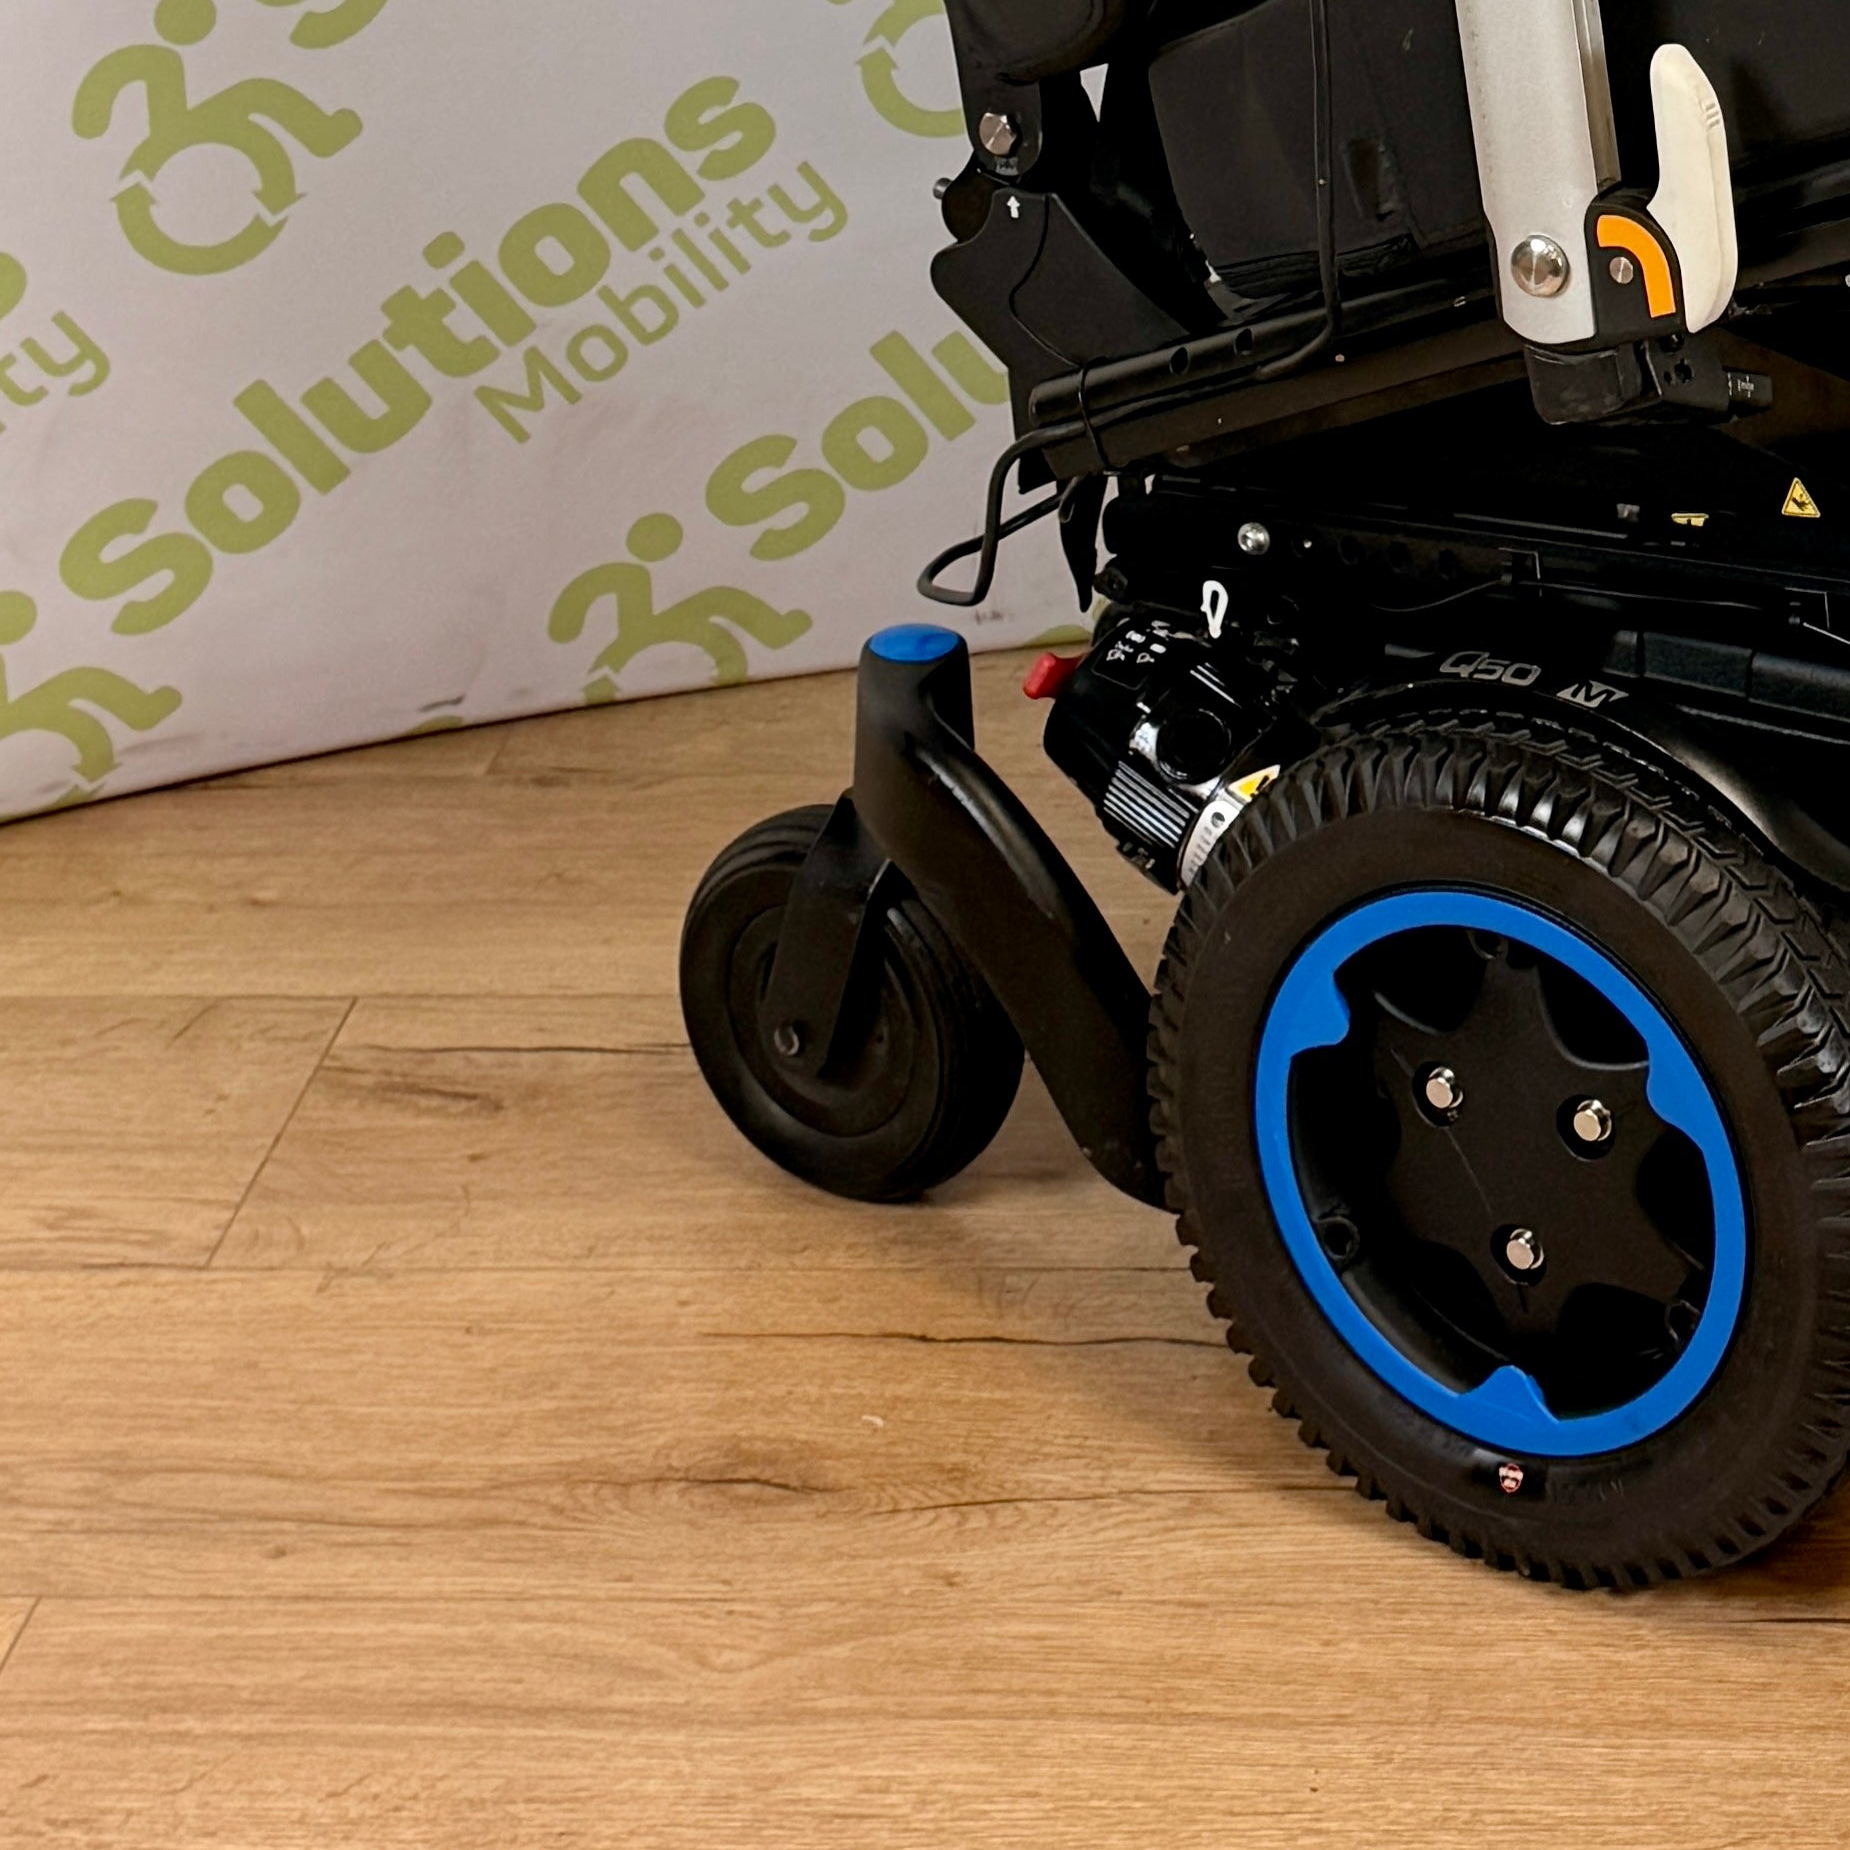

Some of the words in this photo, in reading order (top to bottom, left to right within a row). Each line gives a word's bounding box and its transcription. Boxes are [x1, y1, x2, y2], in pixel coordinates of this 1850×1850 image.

[58, 75, 777, 637] Solutions
[472, 160, 850, 445] Mobility
[1439, 650, 1542, 687] Q50
